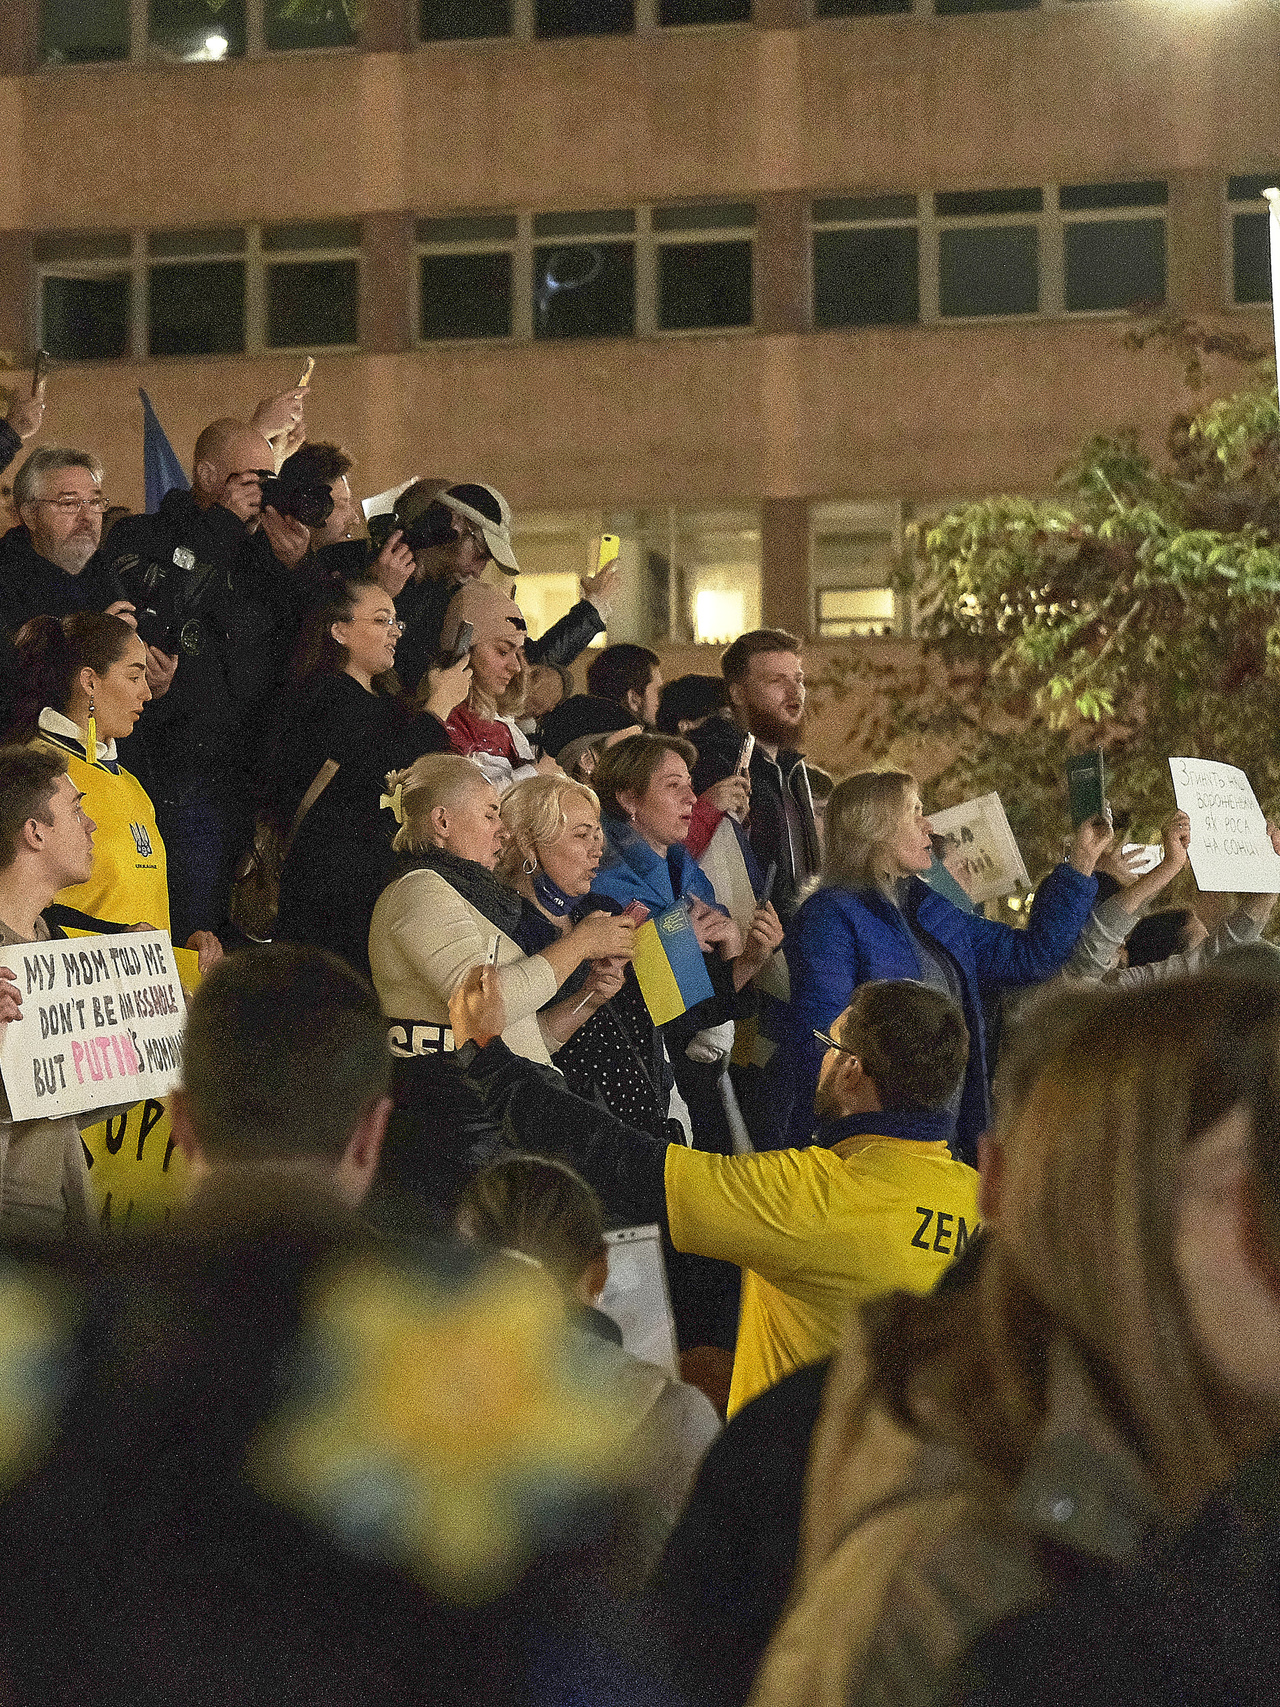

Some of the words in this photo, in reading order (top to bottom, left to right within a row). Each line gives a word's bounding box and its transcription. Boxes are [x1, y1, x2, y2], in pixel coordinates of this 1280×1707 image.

[22, 953, 55, 995] MY
[61, 948, 111, 988] MOM
[109, 946, 142, 978] TOLD
[140, 943, 168, 976] ME
[37, 997, 86, 1040] DON'T
[91, 994, 118, 1028] BE
[118, 992, 136, 1021] AN
[133, 984, 179, 1018] ASSHOLE
[32, 1053, 68, 1098] BUT
[70, 1028, 146, 1085] PUTIN'S
